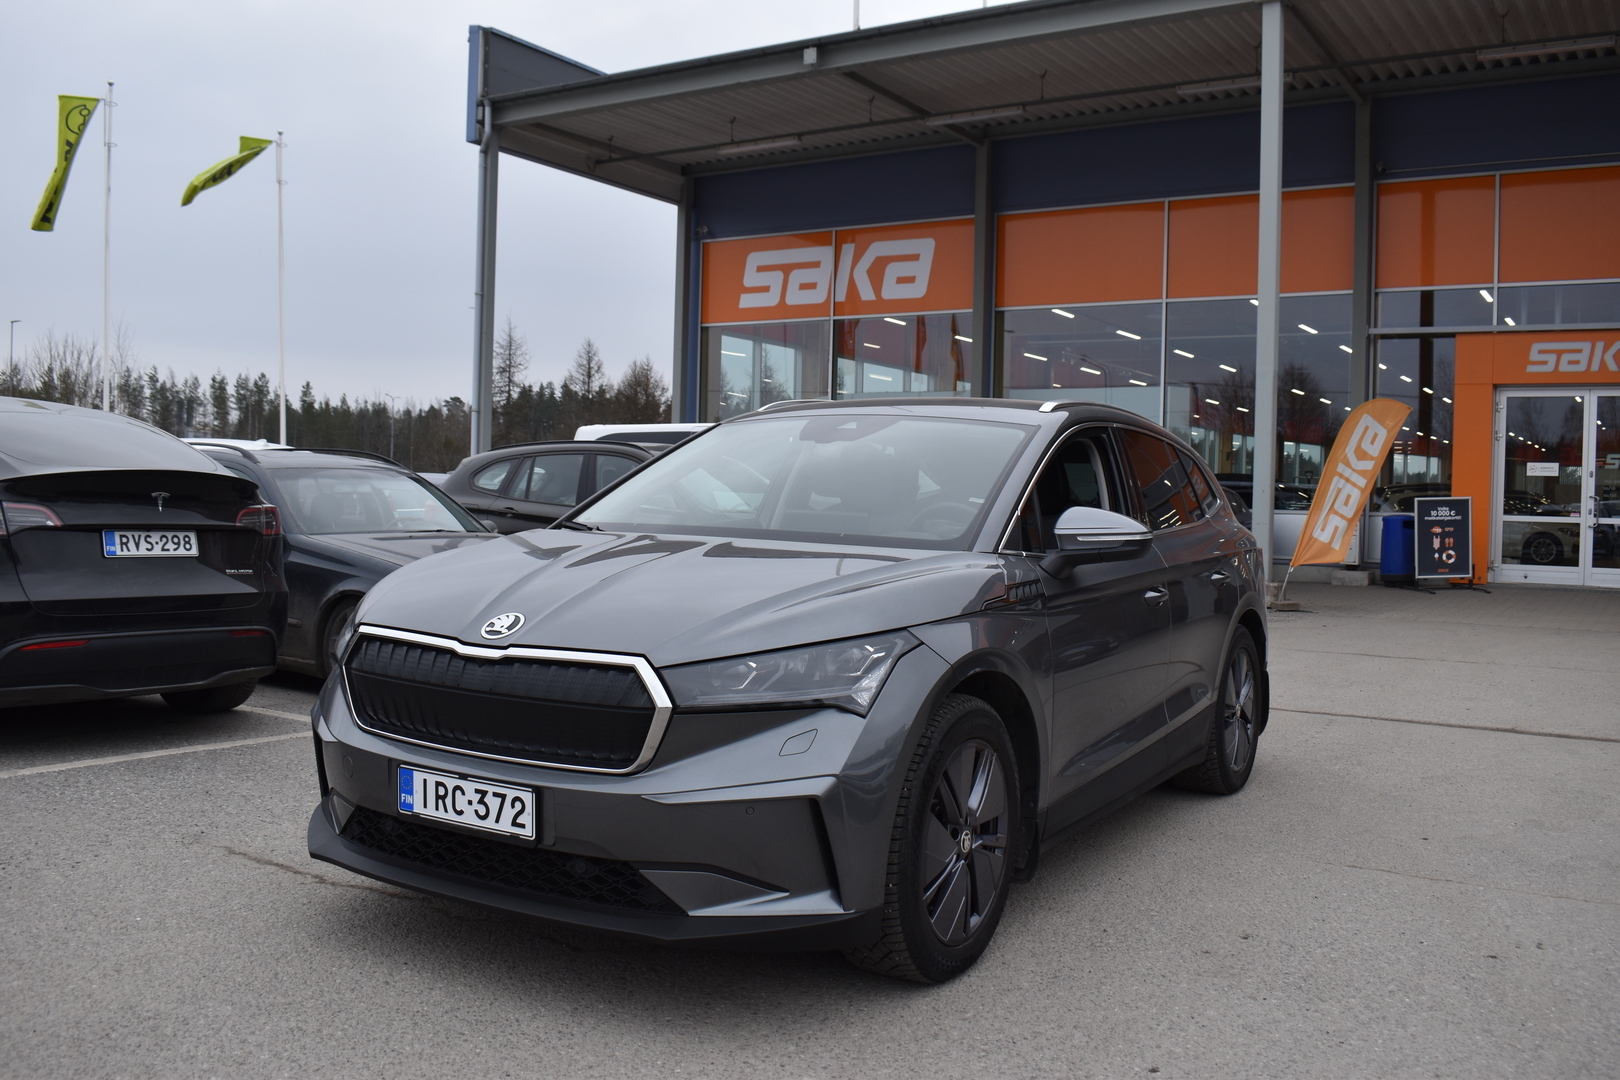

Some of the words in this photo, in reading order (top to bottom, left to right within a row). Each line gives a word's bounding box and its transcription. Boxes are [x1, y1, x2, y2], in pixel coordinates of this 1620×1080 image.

[1525, 340, 1620, 373] sak
[118, 534, 193, 553] RVS-298
[401, 793, 413, 804] FIN
[422, 777, 527, 830] IRC-372
